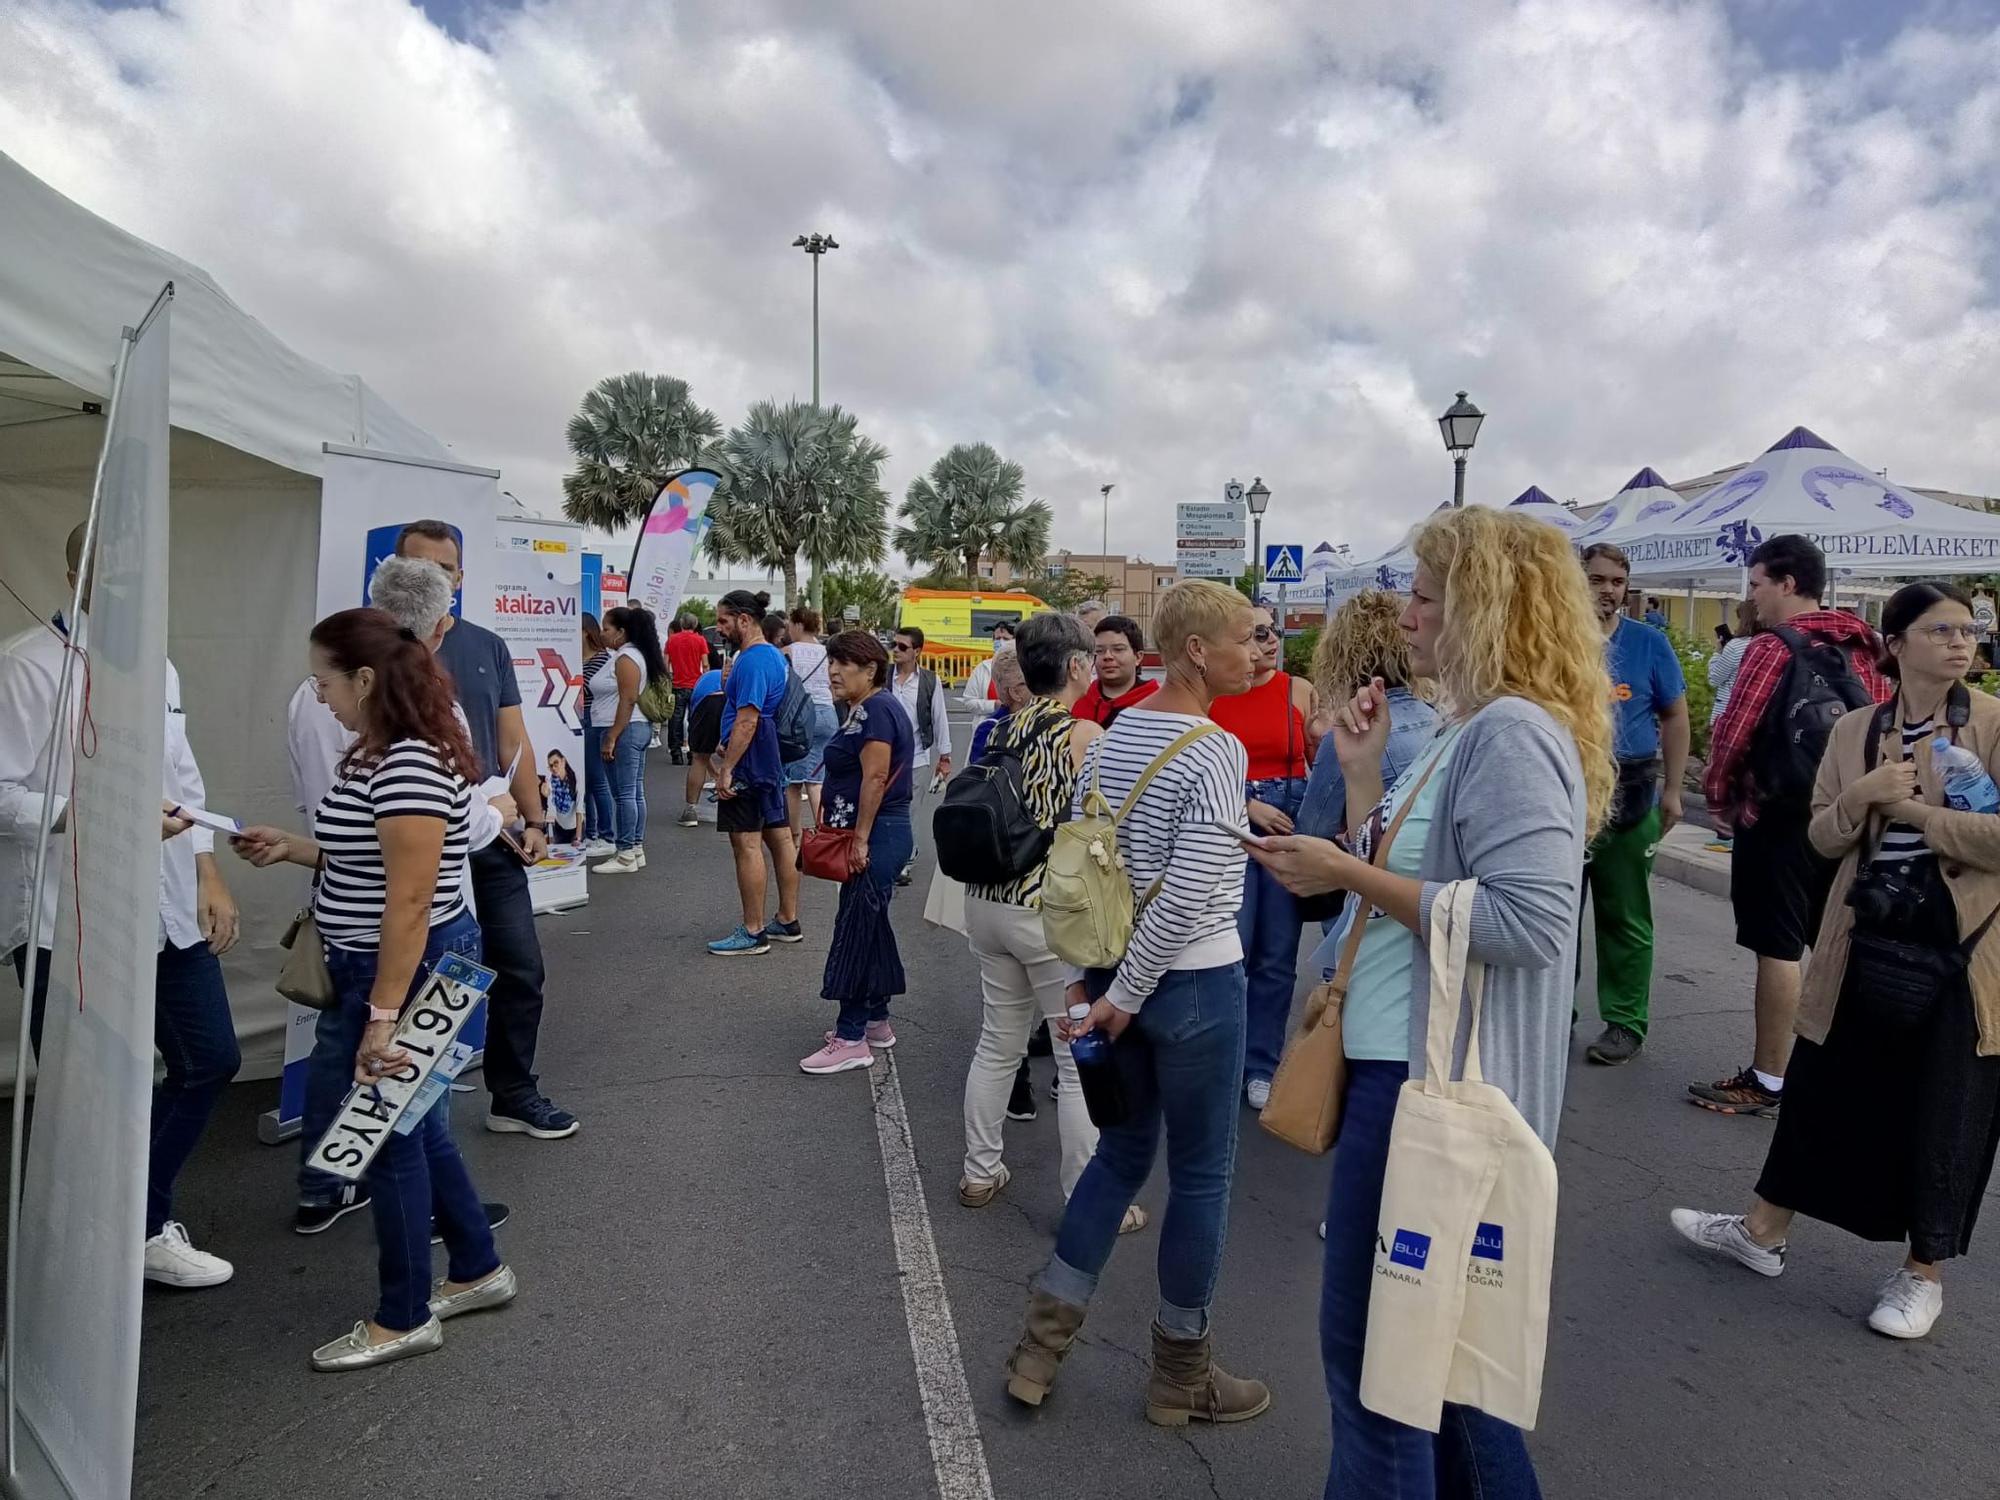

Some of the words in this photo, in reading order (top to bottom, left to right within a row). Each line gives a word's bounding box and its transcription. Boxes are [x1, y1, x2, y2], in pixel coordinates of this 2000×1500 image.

[1394, 1242, 1426, 1259] BLU
[1375, 1265, 1422, 1287] CANARIA
[1486, 1267, 1503, 1278] SPA
